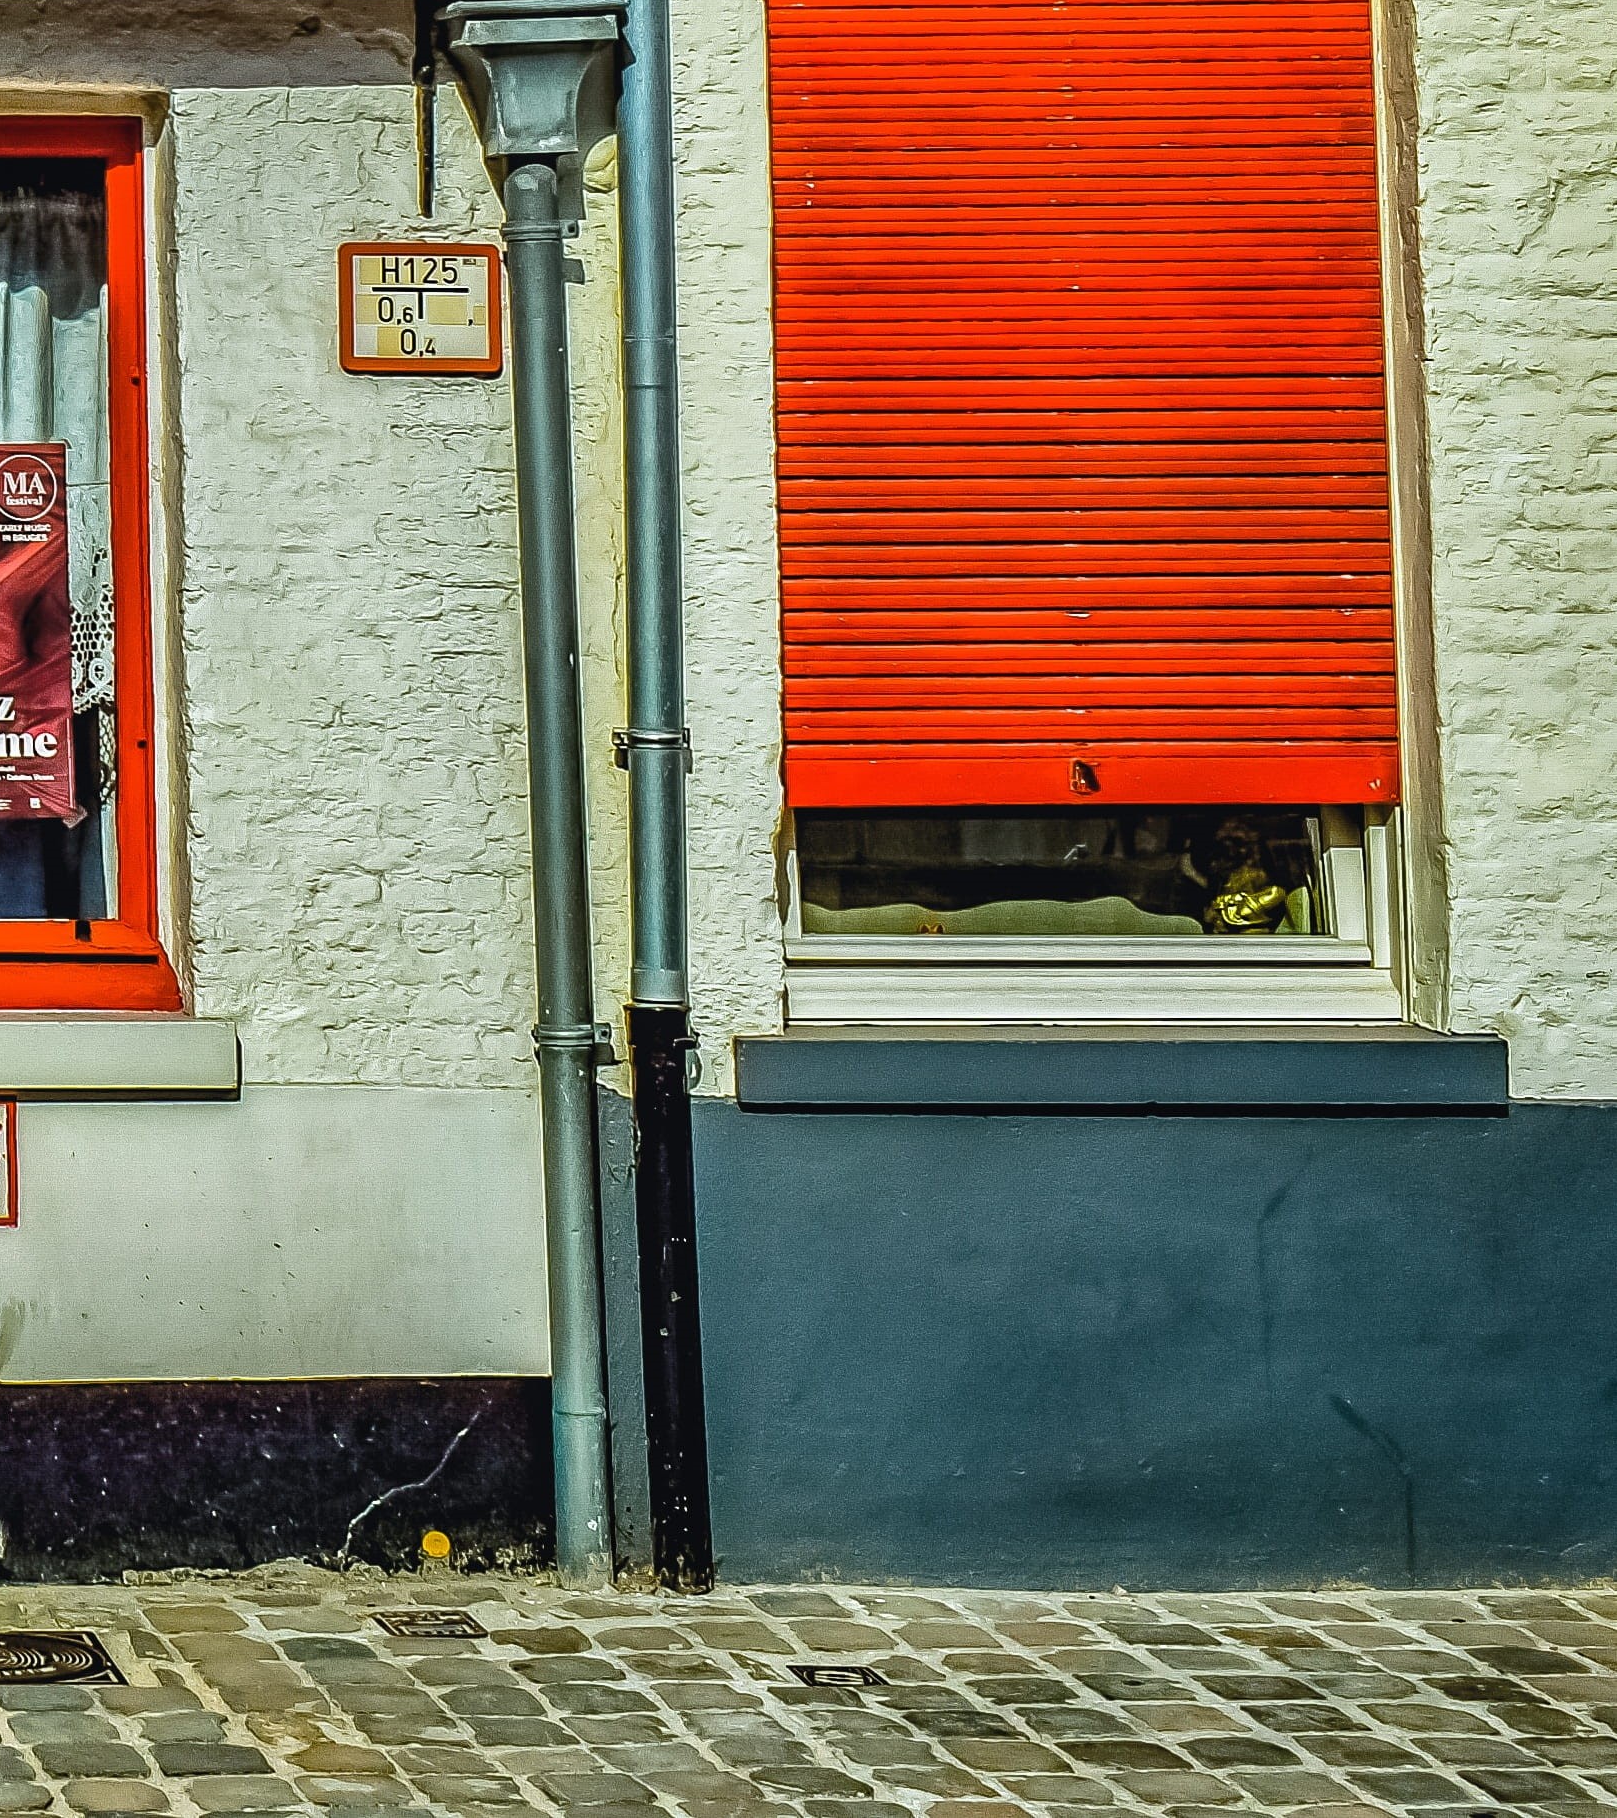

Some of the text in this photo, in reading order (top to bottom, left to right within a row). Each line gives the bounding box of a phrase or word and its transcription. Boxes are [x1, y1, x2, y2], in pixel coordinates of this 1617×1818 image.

[381, 257, 458, 284] H125
[378, 296, 413, 325] 0,6
[400, 329, 436, 357] 0,4
[3, 472, 47, 495] MA
[6, 495, 43, 506] festival
